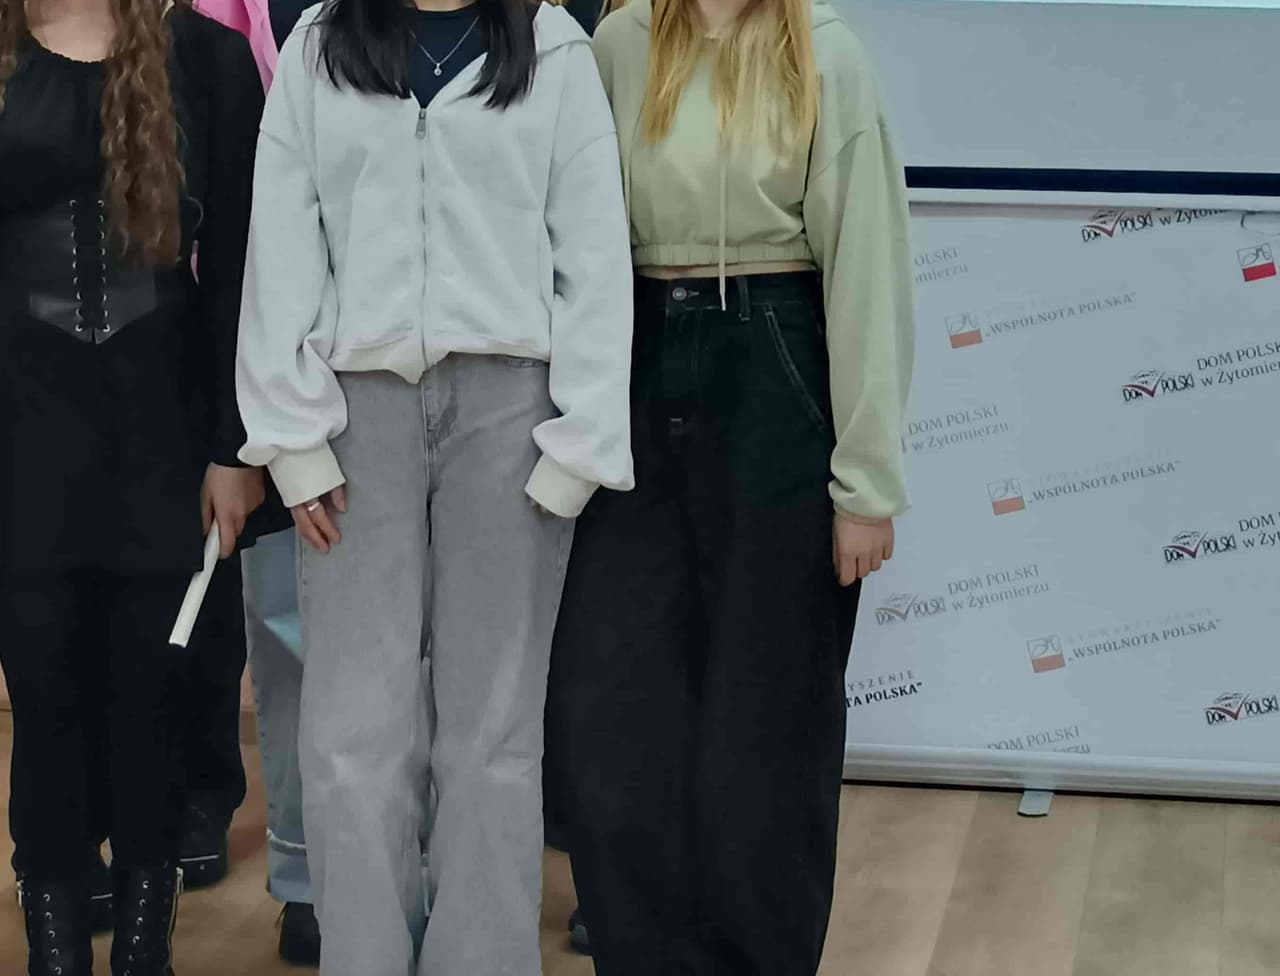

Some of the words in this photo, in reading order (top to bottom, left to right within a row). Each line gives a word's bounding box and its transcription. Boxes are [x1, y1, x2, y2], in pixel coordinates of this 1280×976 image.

[913, 248, 958, 266] OLSKI
[1196, 351, 1233, 371] DOM
[1200, 375, 1214, 387] w
[908, 417, 943, 436] DOM
[946, 403, 999, 427] POLSKI
[1238, 514, 1276, 532] DOM
[1242, 537, 1255, 549] w
[947, 577, 983, 595] DOM
[986, 564, 1040, 587] POLSKI
[951, 600, 964, 612] w
[1026, 724, 1080, 748] POLSKI
